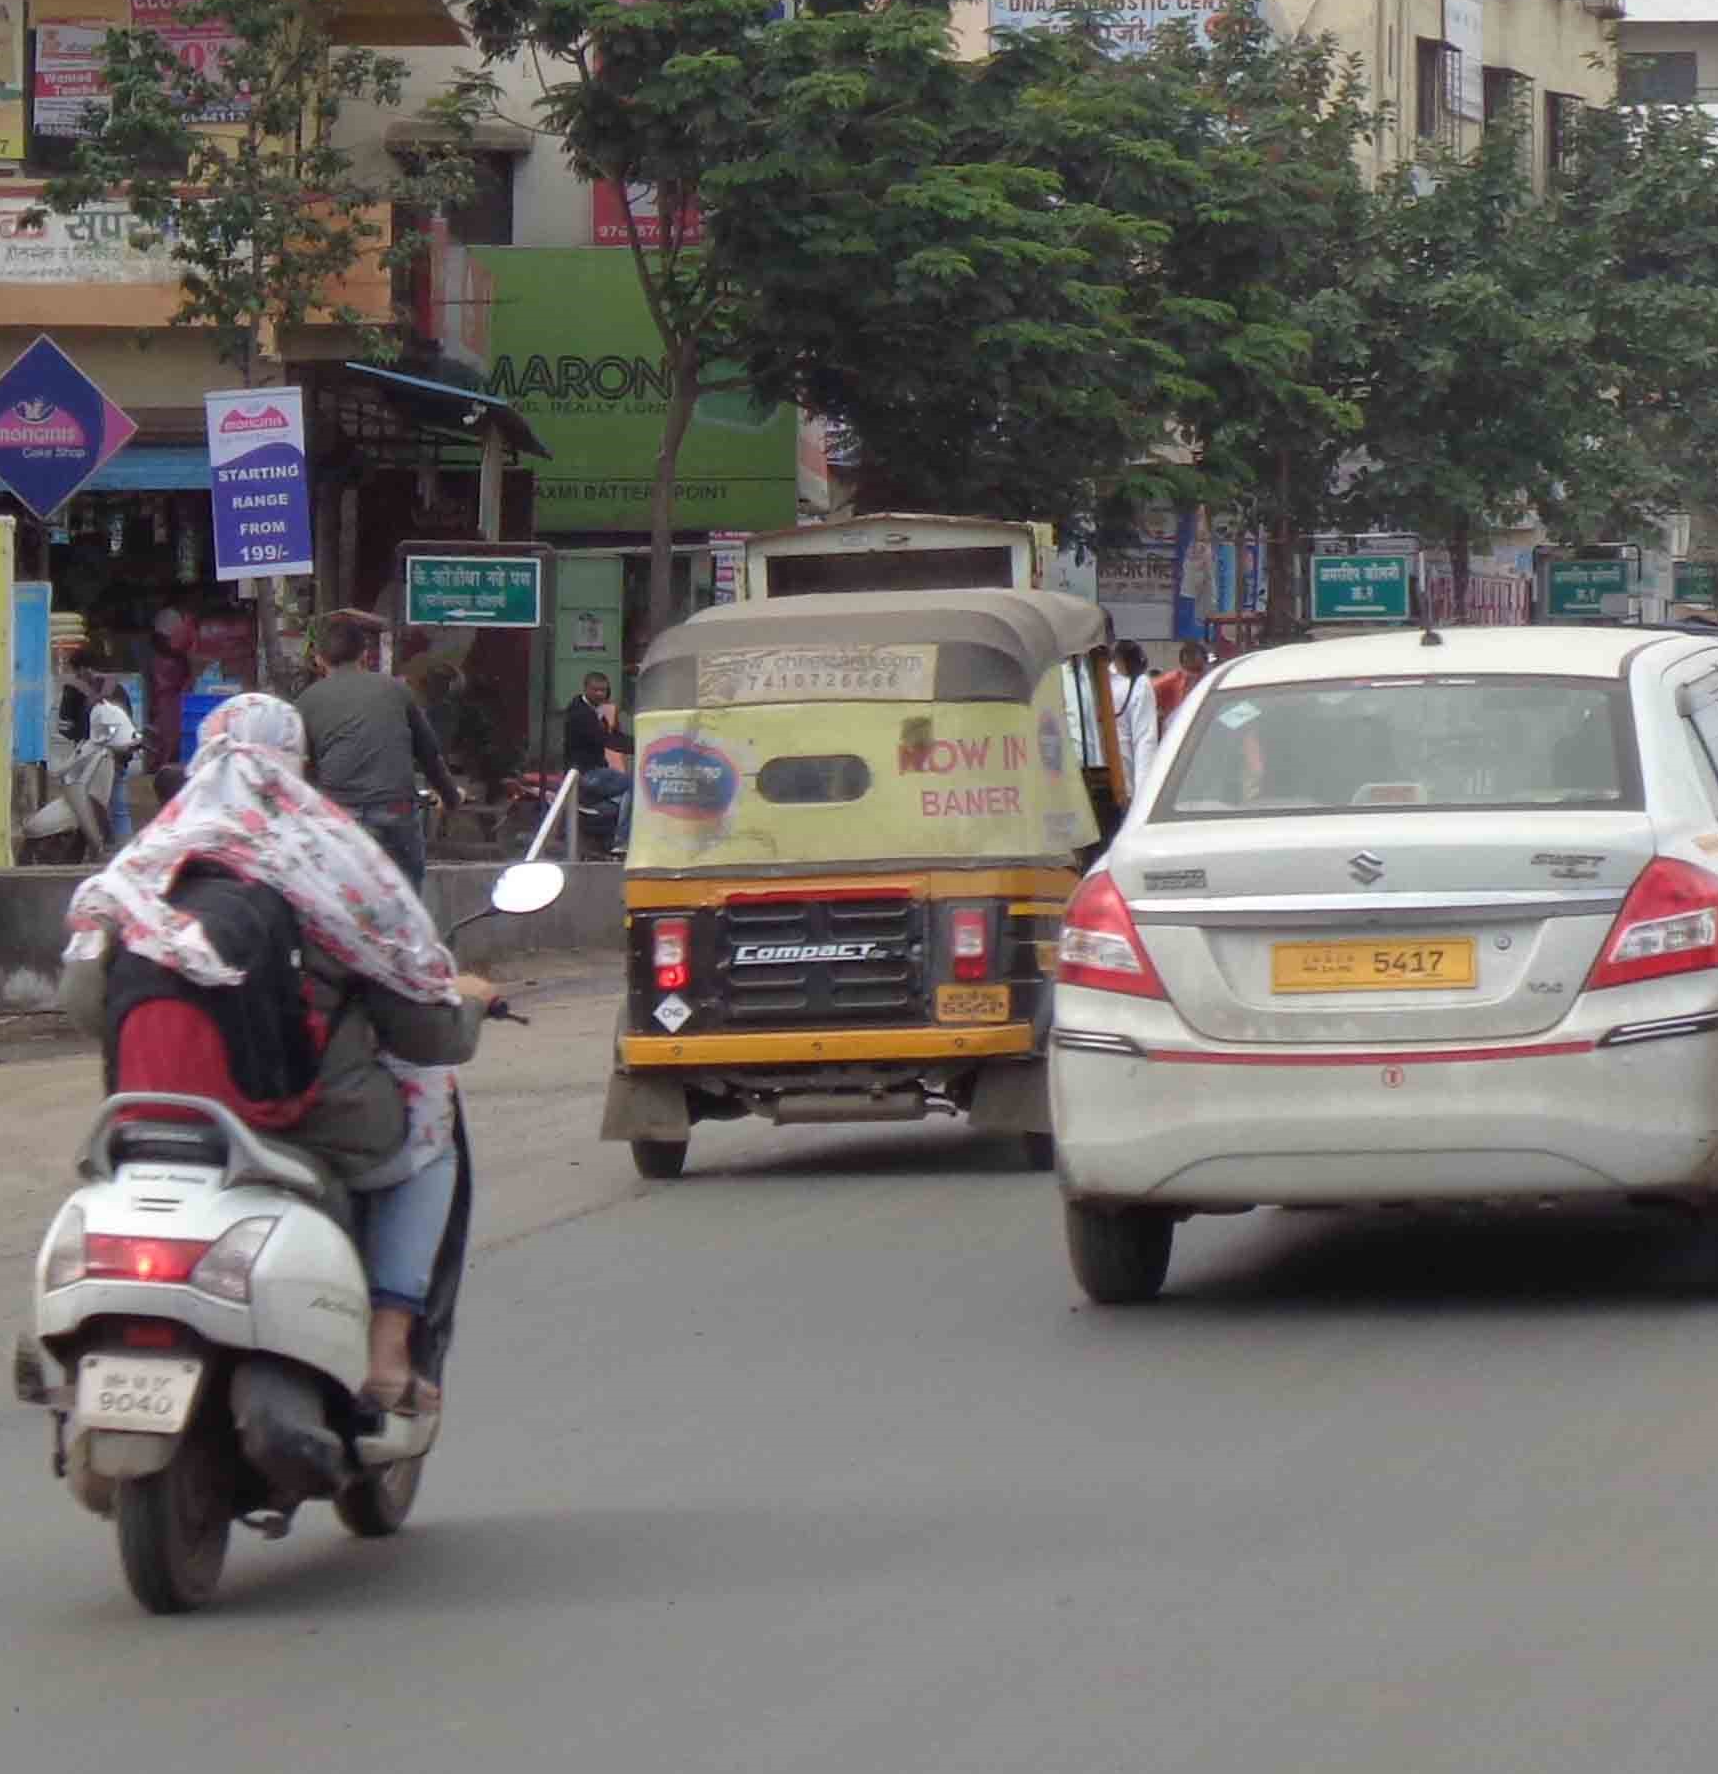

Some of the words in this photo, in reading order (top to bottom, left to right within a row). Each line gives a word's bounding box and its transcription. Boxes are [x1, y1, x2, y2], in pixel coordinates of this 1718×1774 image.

[217, 465, 299, 482] STARTING
[232, 493, 289, 510] RANGE
[238, 521, 286, 537] FROM
[238, 544, 289, 563] 199/-
[1002, 735, 1028, 771] IN
[921, 786, 1022, 818] BANER
[1372, 950, 1445, 974] 5417
[97, 1391, 173, 1416] 9040
